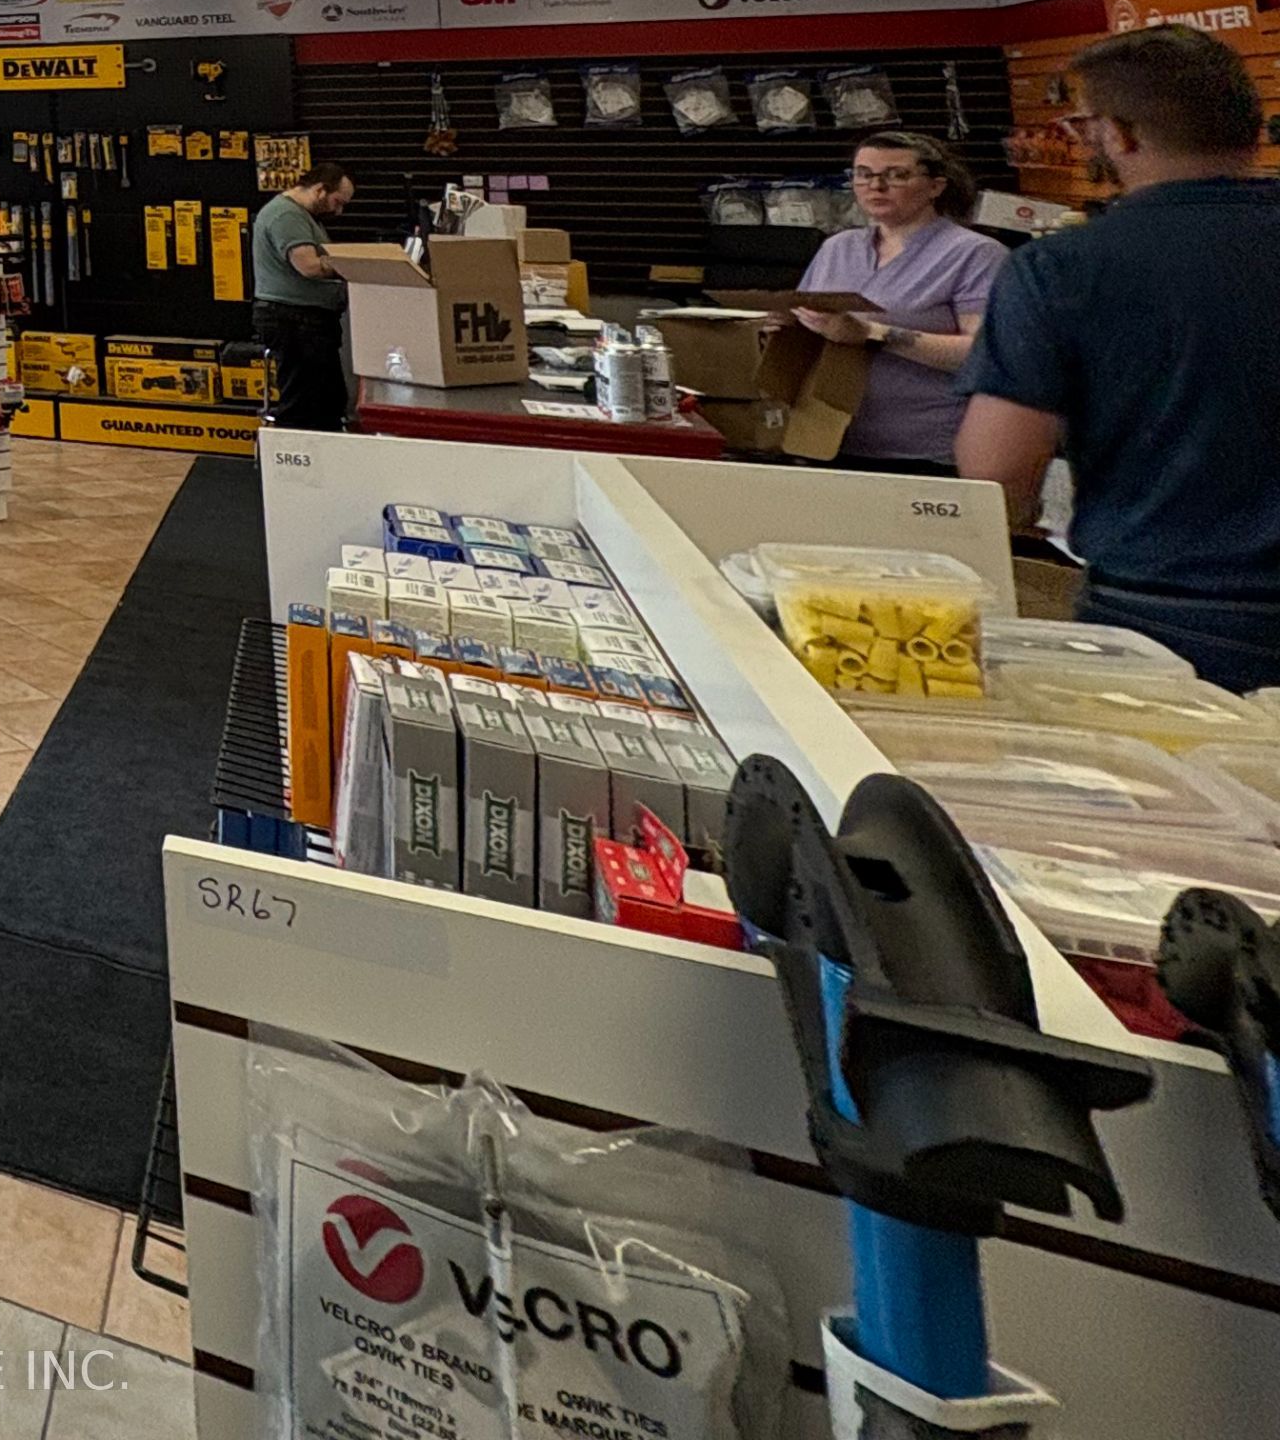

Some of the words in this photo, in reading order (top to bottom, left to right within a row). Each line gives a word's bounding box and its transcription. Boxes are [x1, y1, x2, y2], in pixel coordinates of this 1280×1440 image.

[135, 14, 200, 27] VANGUARD
[202, 13, 236, 26] STEEL
[1168, 6, 1252, 32] WALTER
[100, 418, 204, 437] GUARANTEED
[275, 450, 311, 468] SR63
[909, 500, 961, 518] SR62
[412, 776, 437, 852] DIXON
[489, 797, 514, 875] DIXON
[564, 817, 589, 891] DIXON
[196, 876, 298, 927] SR67
[318, 1295, 396, 1346] VELCRO
[421, 1342, 494, 1384] BRAND
[354, 1336, 409, 1372] QWIK
[411, 1357, 455, 1392] TIES
[366, 1392, 408, 1422] ROLL
[556, 1388, 613, 1423] QWIK
[620, 1407, 669, 1438] TIES
